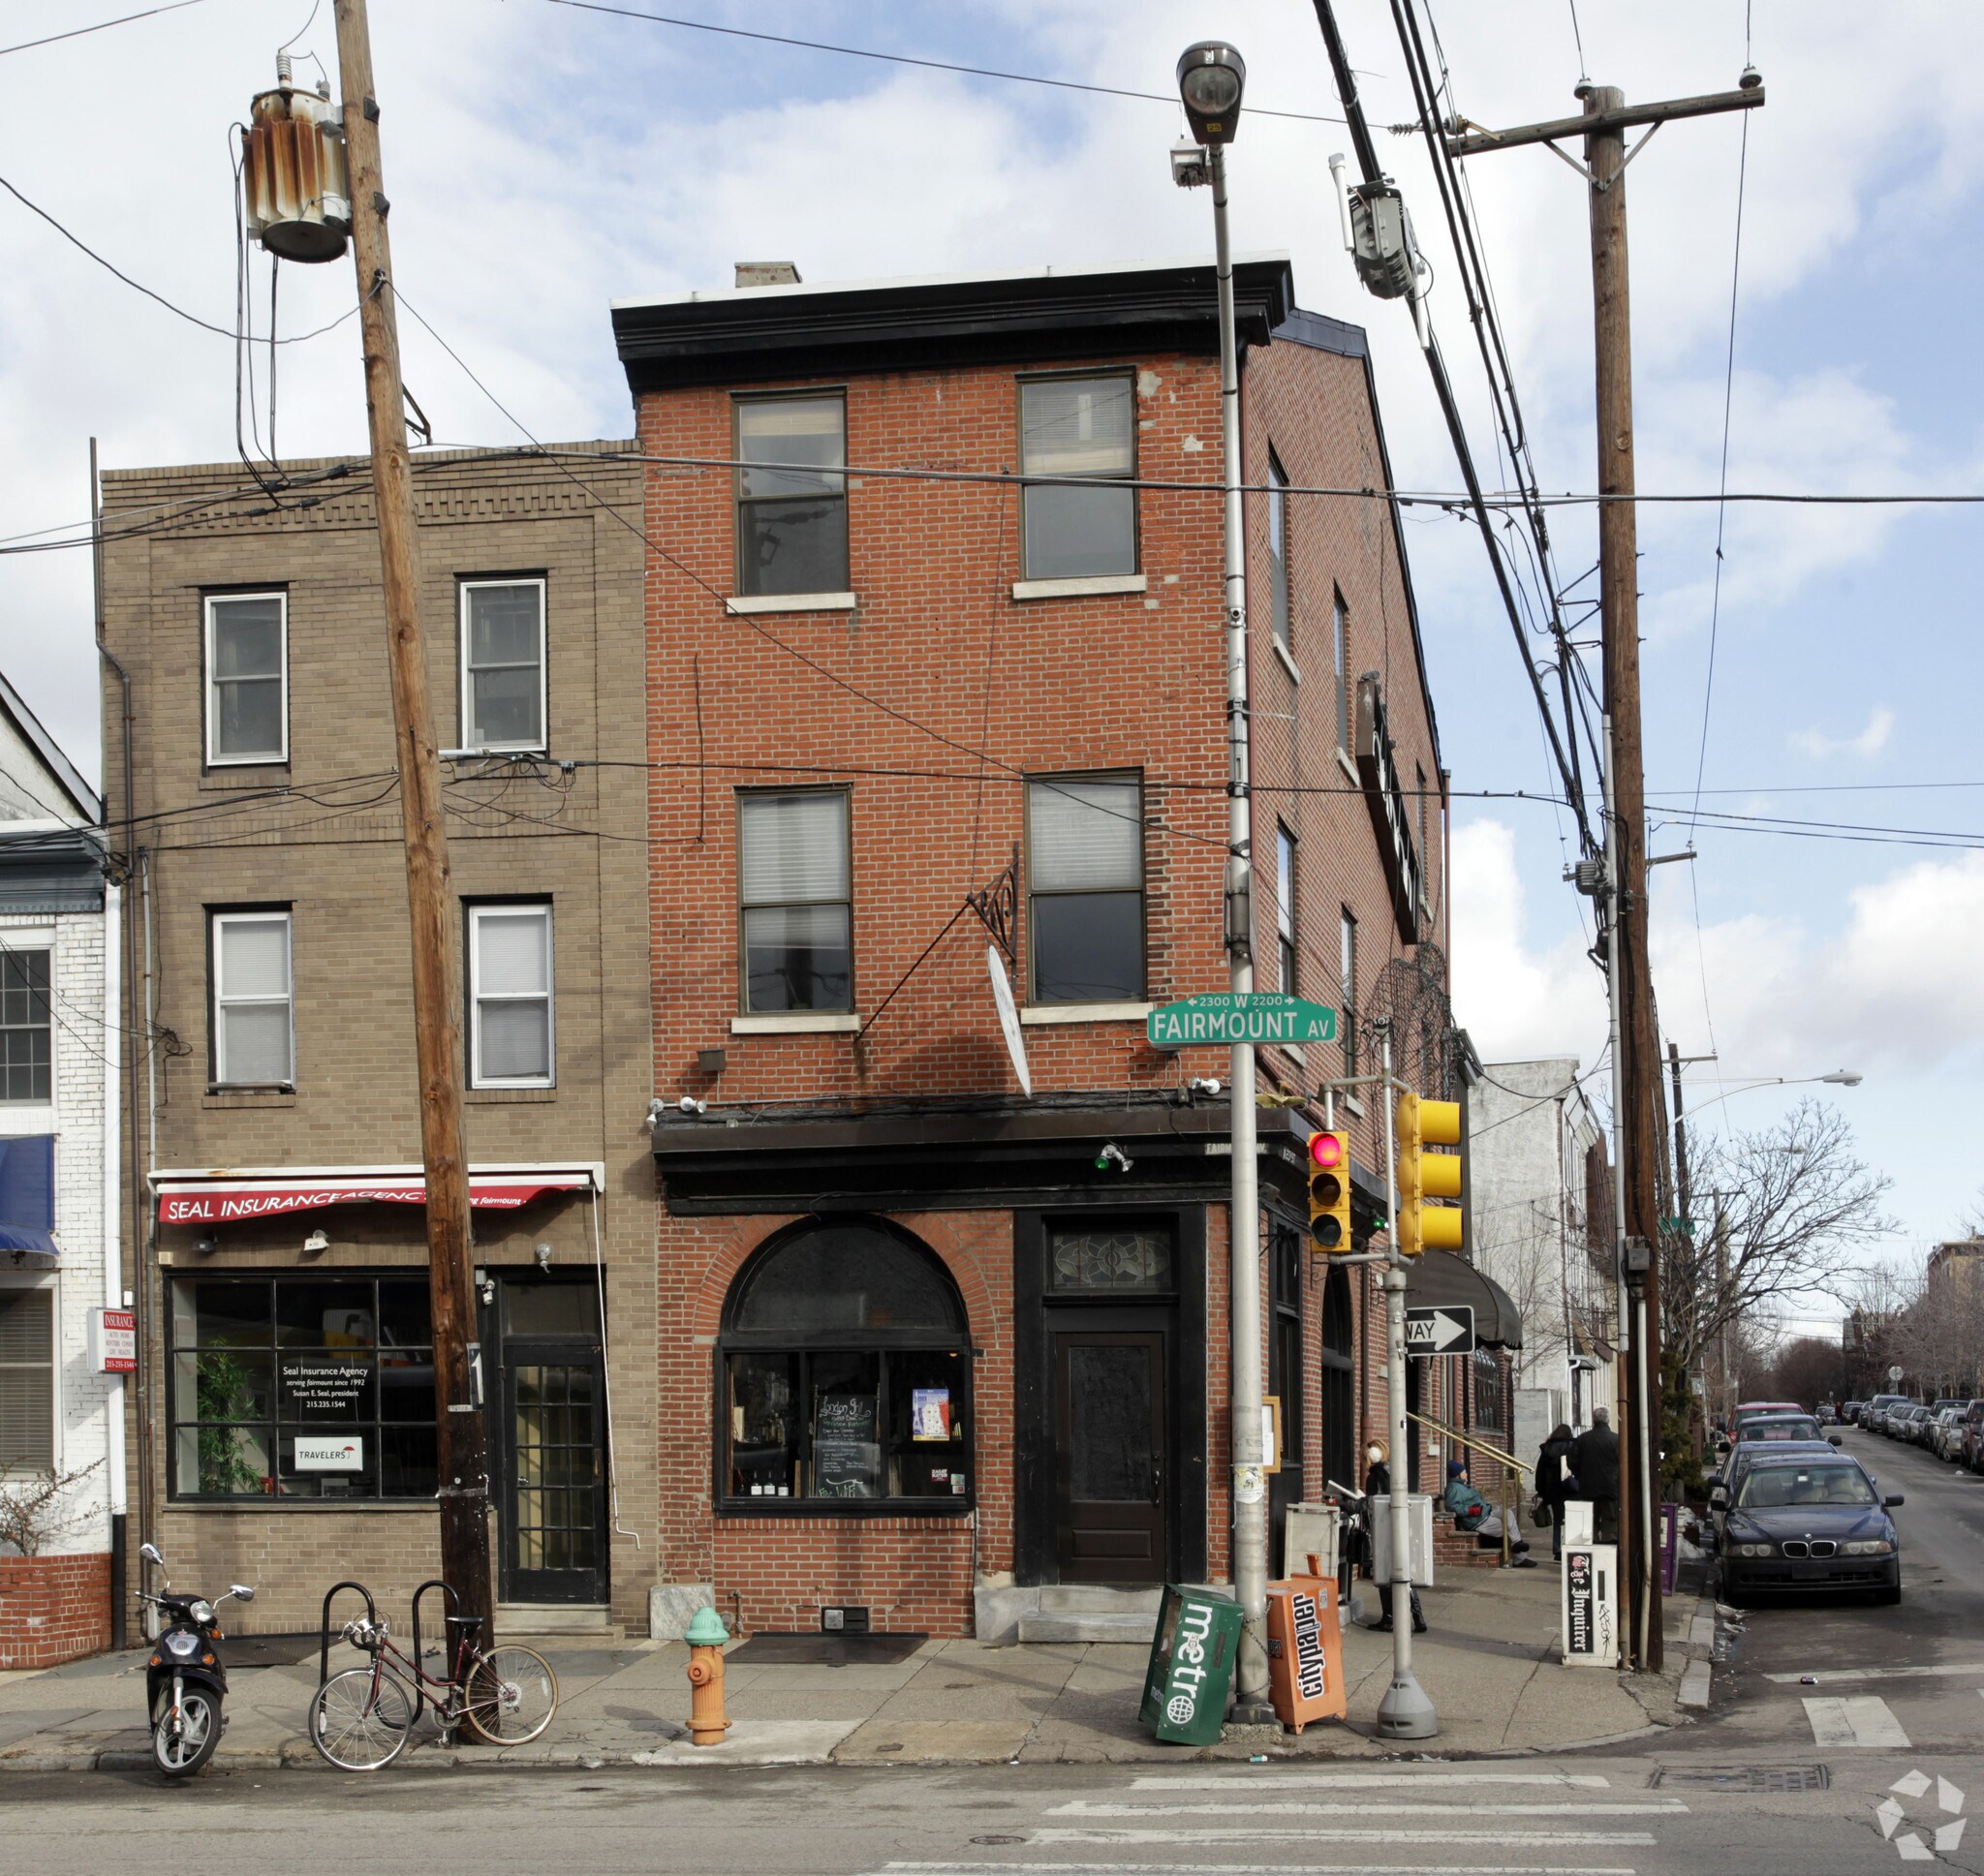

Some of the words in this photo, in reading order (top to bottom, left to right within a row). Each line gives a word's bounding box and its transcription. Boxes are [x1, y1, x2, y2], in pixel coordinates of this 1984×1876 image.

[1199, 997, 1230, 1007] 2300
[1234, 995, 1248, 1008] W
[1252, 997, 1283, 1006] 2200
[1154, 1012, 1297, 1039] FAIRMOUNT
[1308, 1020, 1329, 1037] AV
[1206, 1143, 1232, 1154] FAIRM
[169, 1200, 214, 1219] SEAL
[220, 1192, 341, 1216] INSURANCE
[341, 1190, 426, 1201] AGENC
[480, 1196, 521, 1206] fairmount
[105, 1314, 134, 1327] INSURANCE
[283, 1367, 298, 1375] Seal
[300, 1367, 338, 1375] Insurance
[339, 1367, 368, 1377] Agency
[819, 1396, 849, 1417] London
[1570, 1586, 1591, 1651] Inquirer
[1292, 1593, 1325, 1700] citypaper
